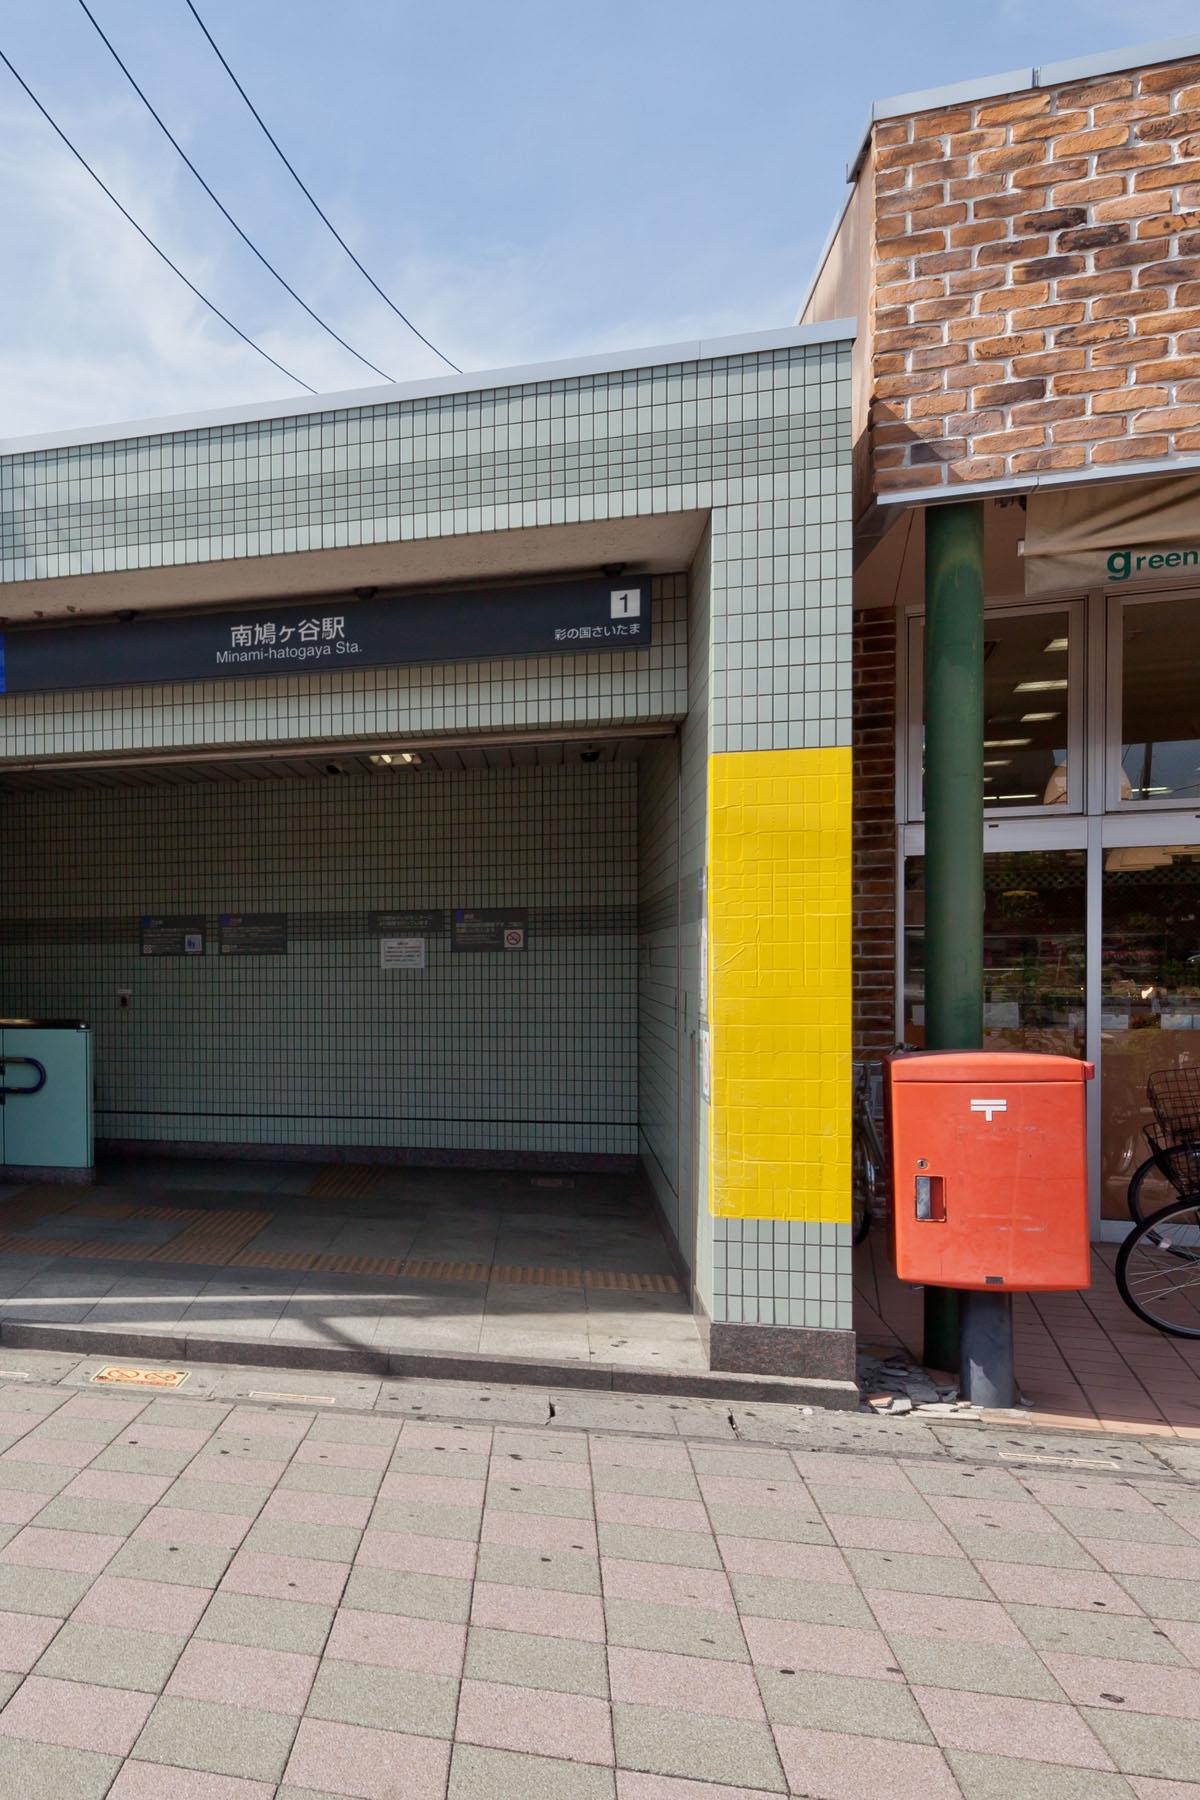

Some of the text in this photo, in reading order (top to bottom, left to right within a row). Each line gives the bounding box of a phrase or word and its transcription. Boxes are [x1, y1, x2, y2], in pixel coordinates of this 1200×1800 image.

[1107, 550, 1198, 580] green
[619, 593, 628, 613] 1
[230, 616, 345, 648] 南鳩ヶ谷駅
[554, 623, 641, 641] 彩の国さいたま
[216, 640, 363, 664] Minami-hatogaya Sta.
